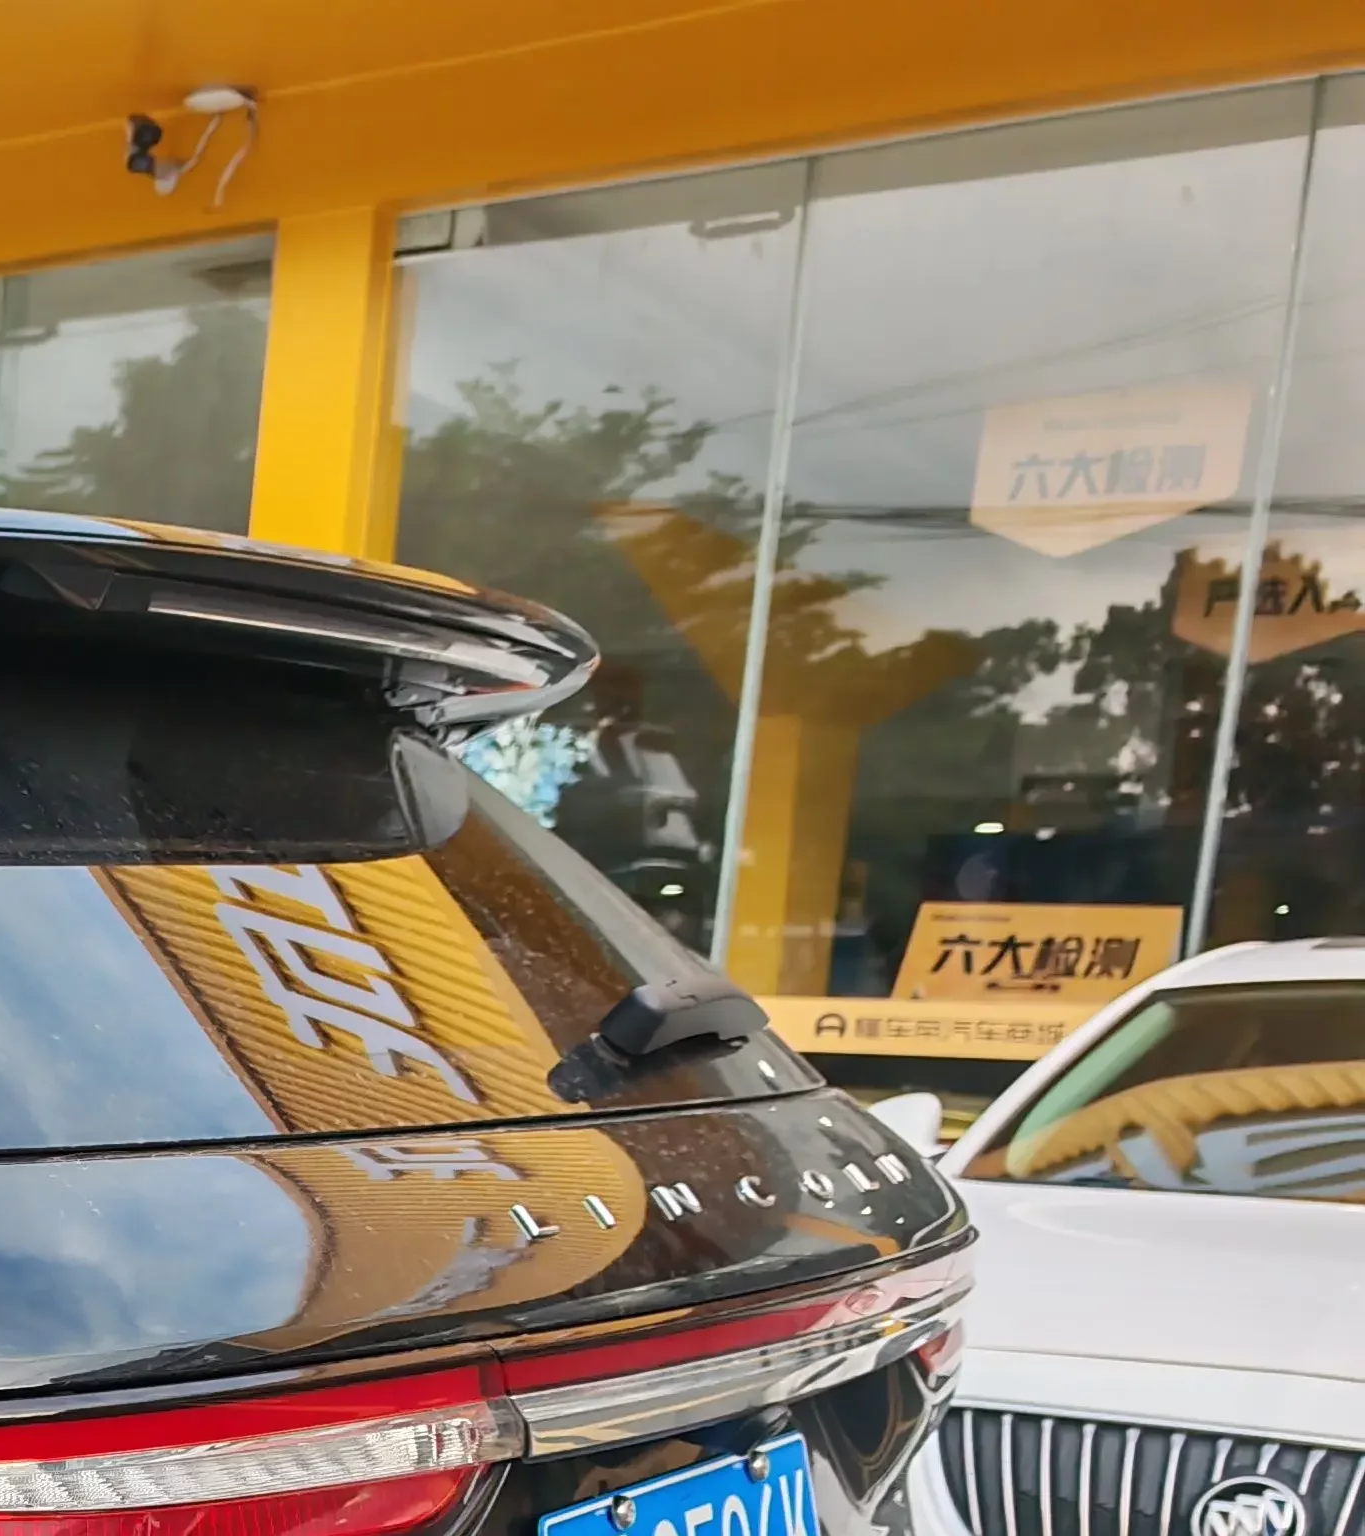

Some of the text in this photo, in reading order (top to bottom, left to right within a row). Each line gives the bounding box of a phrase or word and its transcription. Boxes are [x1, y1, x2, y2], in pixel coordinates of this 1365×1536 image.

[930, 934, 1142, 980] 六大检测
[508, 1153, 912, 1240] LINCOLN
